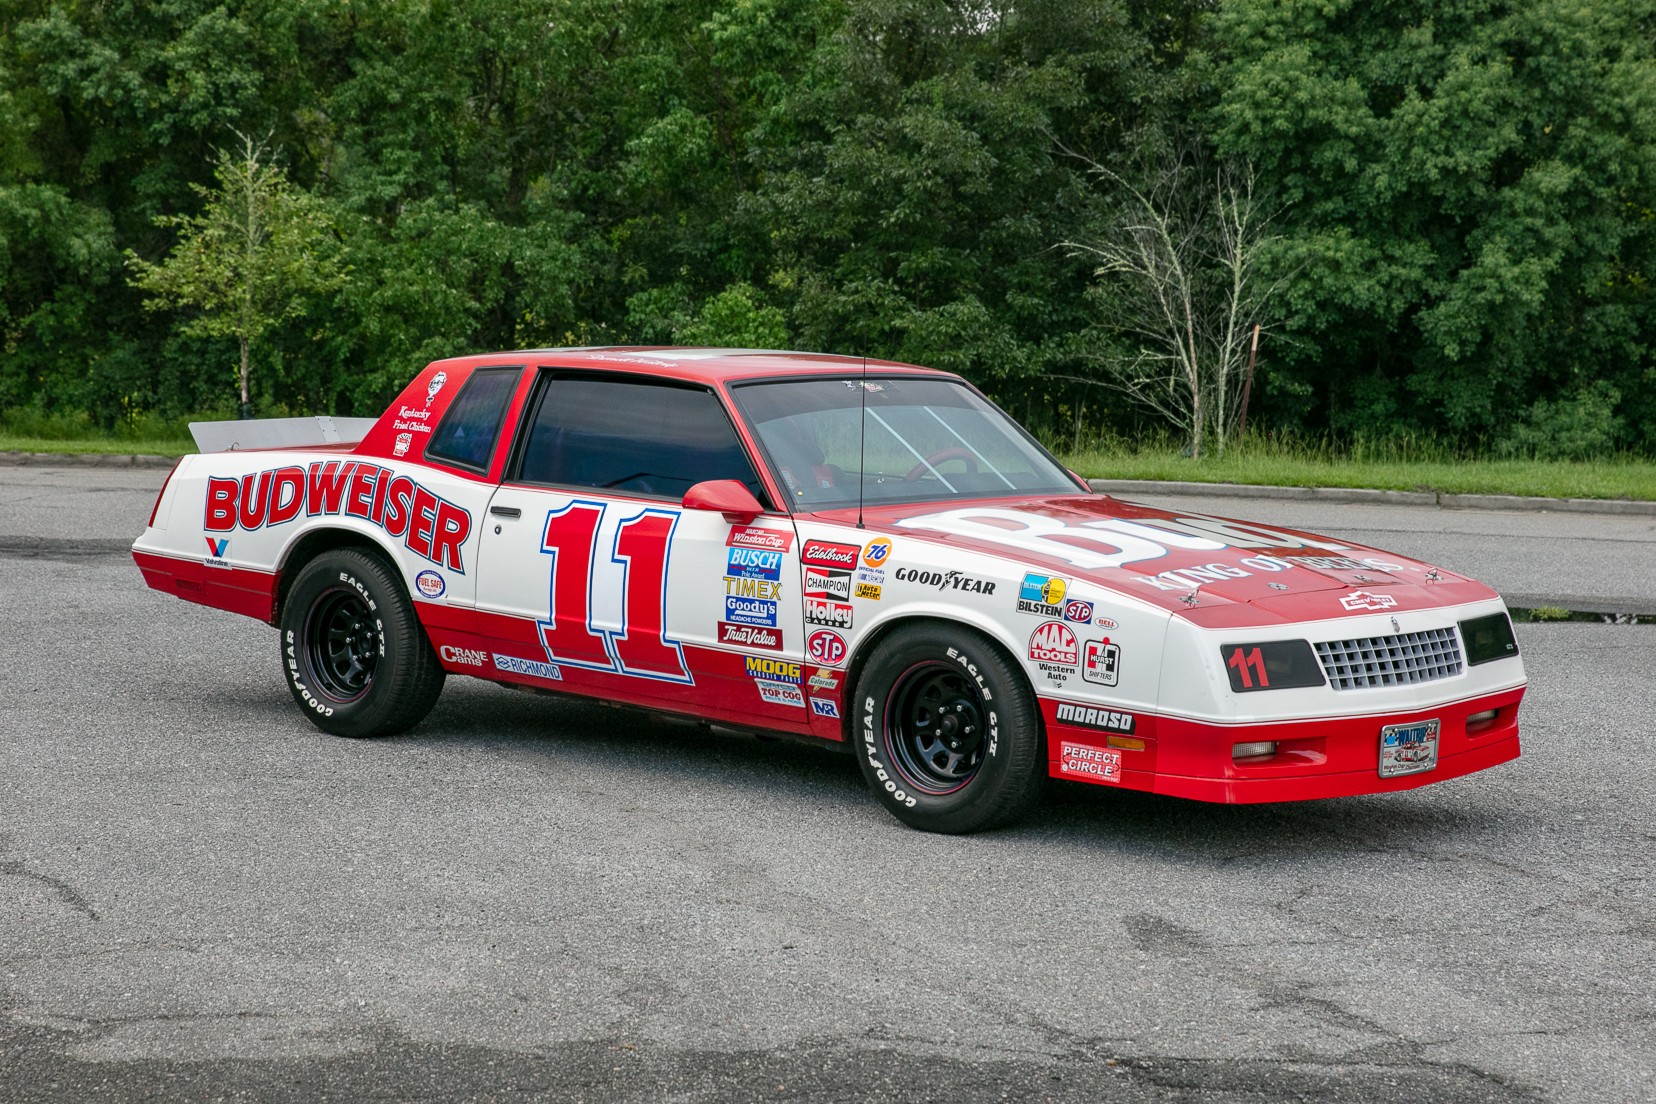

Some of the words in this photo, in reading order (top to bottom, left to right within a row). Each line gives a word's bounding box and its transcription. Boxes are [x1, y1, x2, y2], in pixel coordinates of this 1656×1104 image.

[398, 405, 431, 420] Kentucky
[393, 420, 410, 430] Fried
[409, 422, 431, 433] Chicken
[204, 461, 472, 575] BUDWEISER
[733, 533, 766, 545] Winston
[766, 536, 785, 548] Cup
[730, 549, 779, 570] BUSCH
[807, 545, 854, 564] Edelbrock
[866, 545, 888, 560] 76
[205, 558, 229, 567] Valvoline
[418, 577, 429, 587] FUEL
[430, 579, 442, 590] SAFE
[807, 577, 848, 592] CHAMPION
[1130, 563, 1253, 591] KING
[339, 572, 377, 611] EAGLE
[536, 499, 696, 687] 11
[723, 576, 782, 601] TIMEX
[861, 591, 880, 599] Meter
[863, 585, 878, 593] Auto
[727, 598, 776, 617] Goody's
[806, 600, 852, 628] Holley
[1018, 600, 1063, 617] BILSTEIN
[1068, 603, 1089, 620] STP
[730, 615, 752, 624] HEADACHE
[1098, 618, 1116, 627] BELL
[812, 633, 843, 661] STP
[1032, 624, 1076, 657] MAC
[1031, 648, 1076, 664] TOOLS
[1090, 654, 1114, 665] HURST
[286, 630, 335, 717] GOODYEAR
[509, 658, 561, 679] RICHMOND
[746, 657, 801, 679] MOOG
[946, 647, 993, 702] EAGLE
[1039, 663, 1076, 674] Western
[1047, 671, 1068, 681] Auto
[1088, 670, 1113, 681] SHIFTERS
[1229, 647, 1270, 689] 11
[761, 687, 781, 698] TOP
[782, 690, 802, 701] COG
[1056, 703, 1134, 731] MOROSO
[864, 697, 917, 807] GOODYEAR
[1063, 746, 1120, 765] PERFECT
[1068, 760, 1114, 777] CIRCLE
